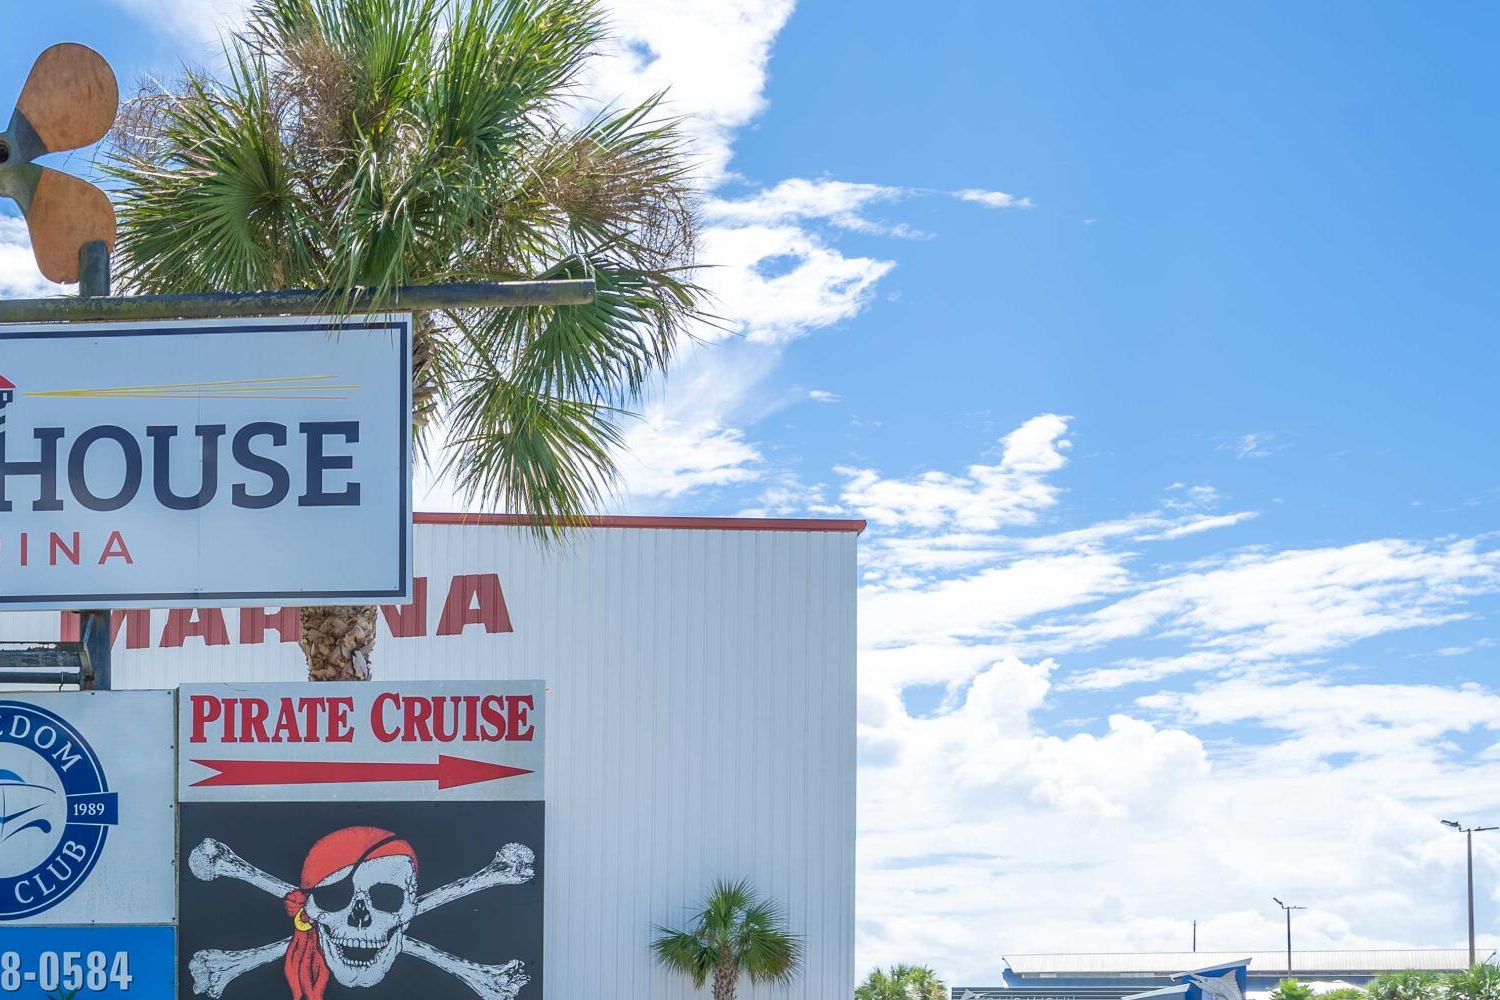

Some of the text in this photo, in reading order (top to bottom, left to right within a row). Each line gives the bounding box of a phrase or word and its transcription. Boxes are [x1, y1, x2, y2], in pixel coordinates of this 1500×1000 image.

[60, 573, 514, 649] MARNA
[189, 692, 535, 743] PIRATE CRUISE
[73, 803, 105, 816] 1989
[14, 839, 86, 904] CLUB
